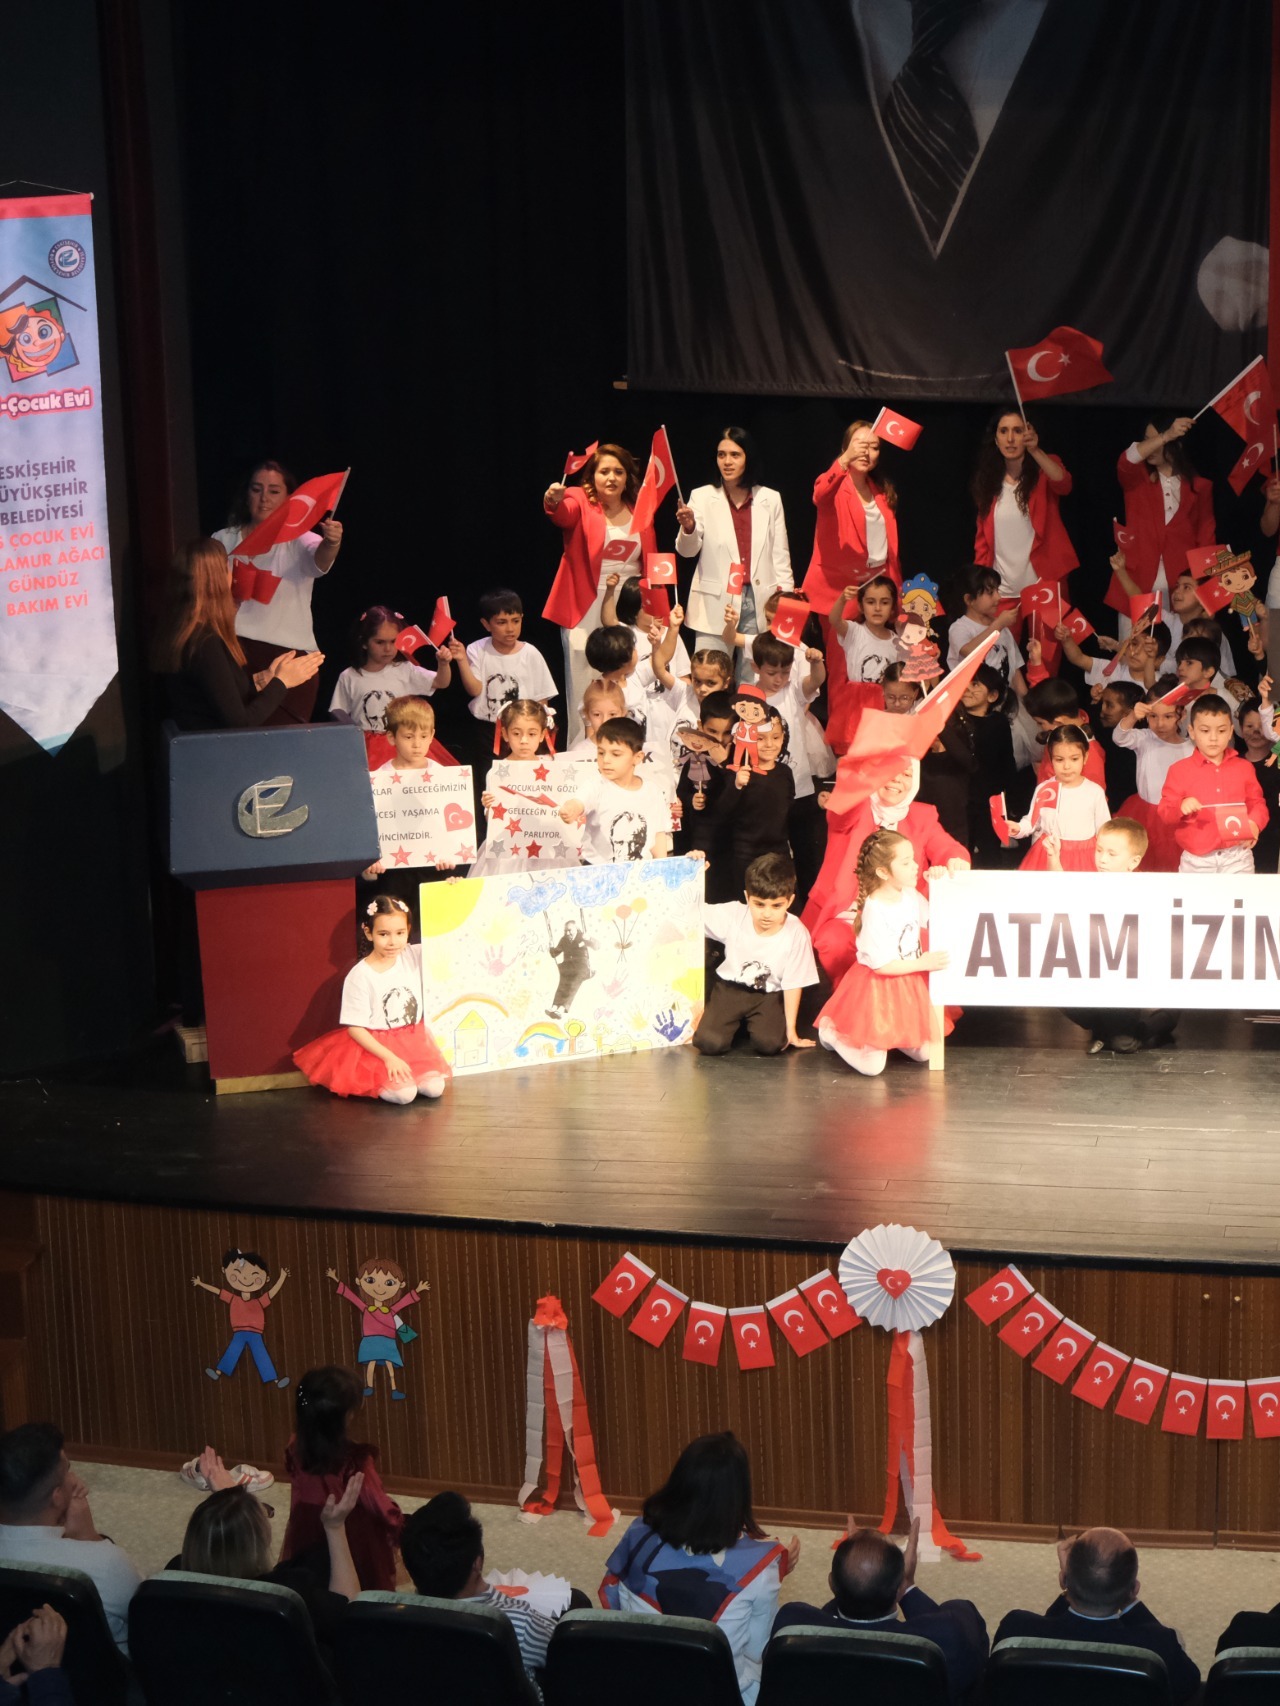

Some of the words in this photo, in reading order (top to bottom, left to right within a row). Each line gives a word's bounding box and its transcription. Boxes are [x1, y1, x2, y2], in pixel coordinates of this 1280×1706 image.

[63, 389, 91, 408] Evi
[0, 456, 76, 481] ESKİŞEHİR
[1, 500, 83, 525] BELEDİYESİ
[10, 529, 65, 551] ÇOCUK
[70, 521, 94, 541] EVİ
[57, 546, 105, 565] AĞACI
[8, 569, 79, 593] GÜNDÜZ
[7, 597, 59, 616] BAKIM
[64, 590, 88, 609] EVİ
[402, 807, 440, 819] YAŞAMA
[523, 830, 562, 839] PARLIYOR.
[964, 912, 1139, 980] ATAM
